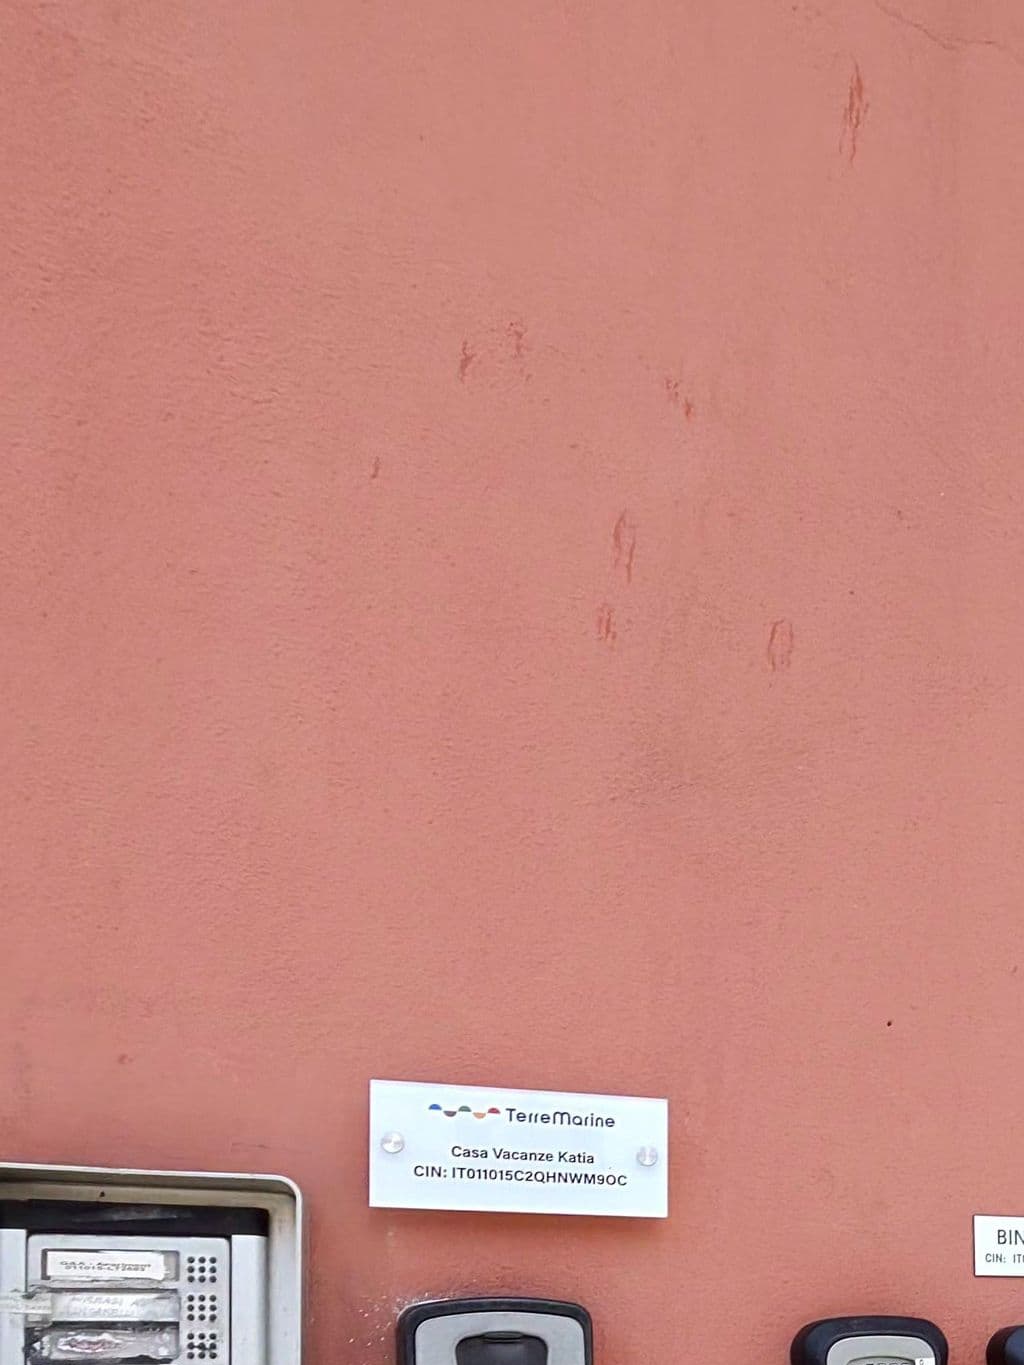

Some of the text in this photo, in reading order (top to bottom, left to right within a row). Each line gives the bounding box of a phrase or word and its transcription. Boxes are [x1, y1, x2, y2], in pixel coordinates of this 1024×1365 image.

[505, 1108, 616, 1128] TerreMarine
[451, 1145, 595, 1164] Casa Vacanze Katia
[413, 1165, 447, 1178] CIN:
[985, 1253, 1007, 1264] CIN:
